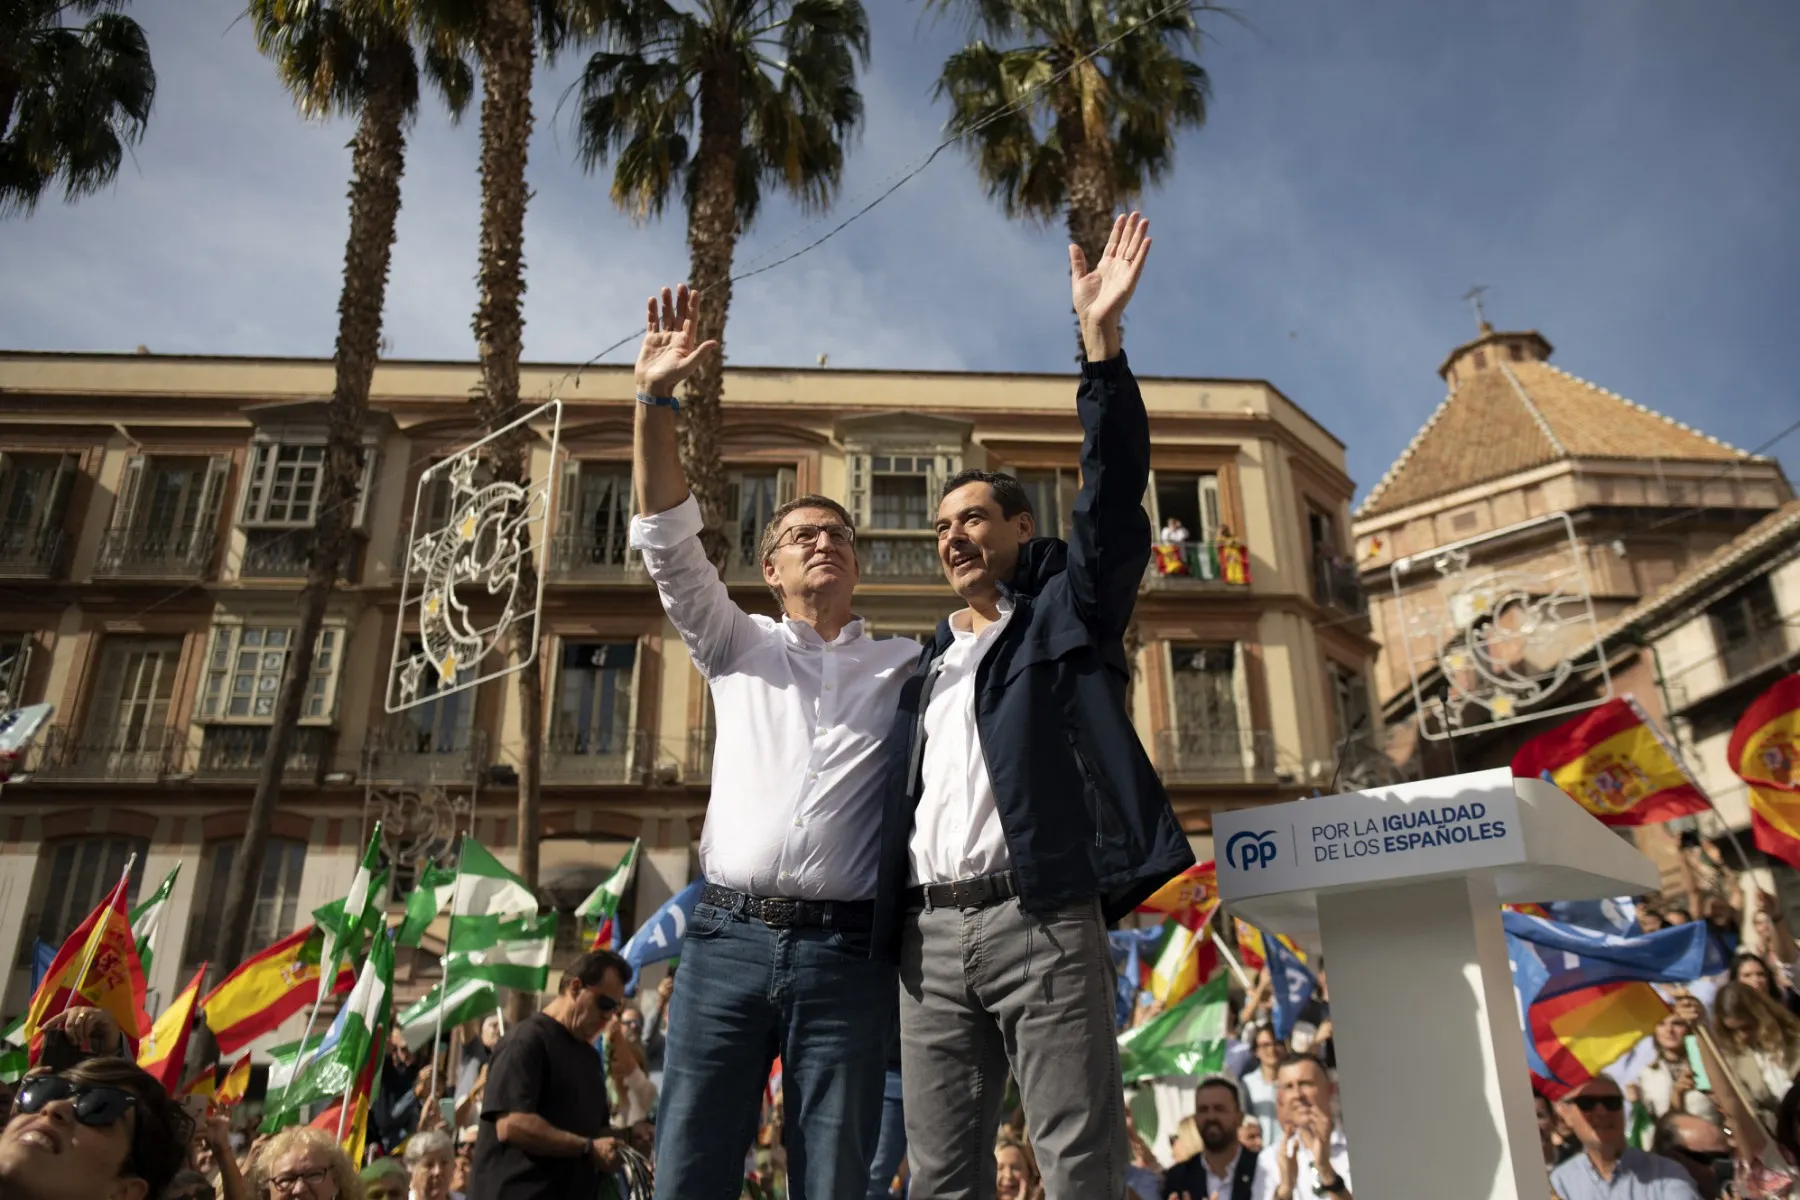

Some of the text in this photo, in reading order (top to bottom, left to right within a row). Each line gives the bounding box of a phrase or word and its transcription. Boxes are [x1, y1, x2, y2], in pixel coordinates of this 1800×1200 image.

[1312, 802, 1486, 842] POR LA IGUALDAD
[1314, 820, 1506, 862] DE LOS ESPAÑOLES
